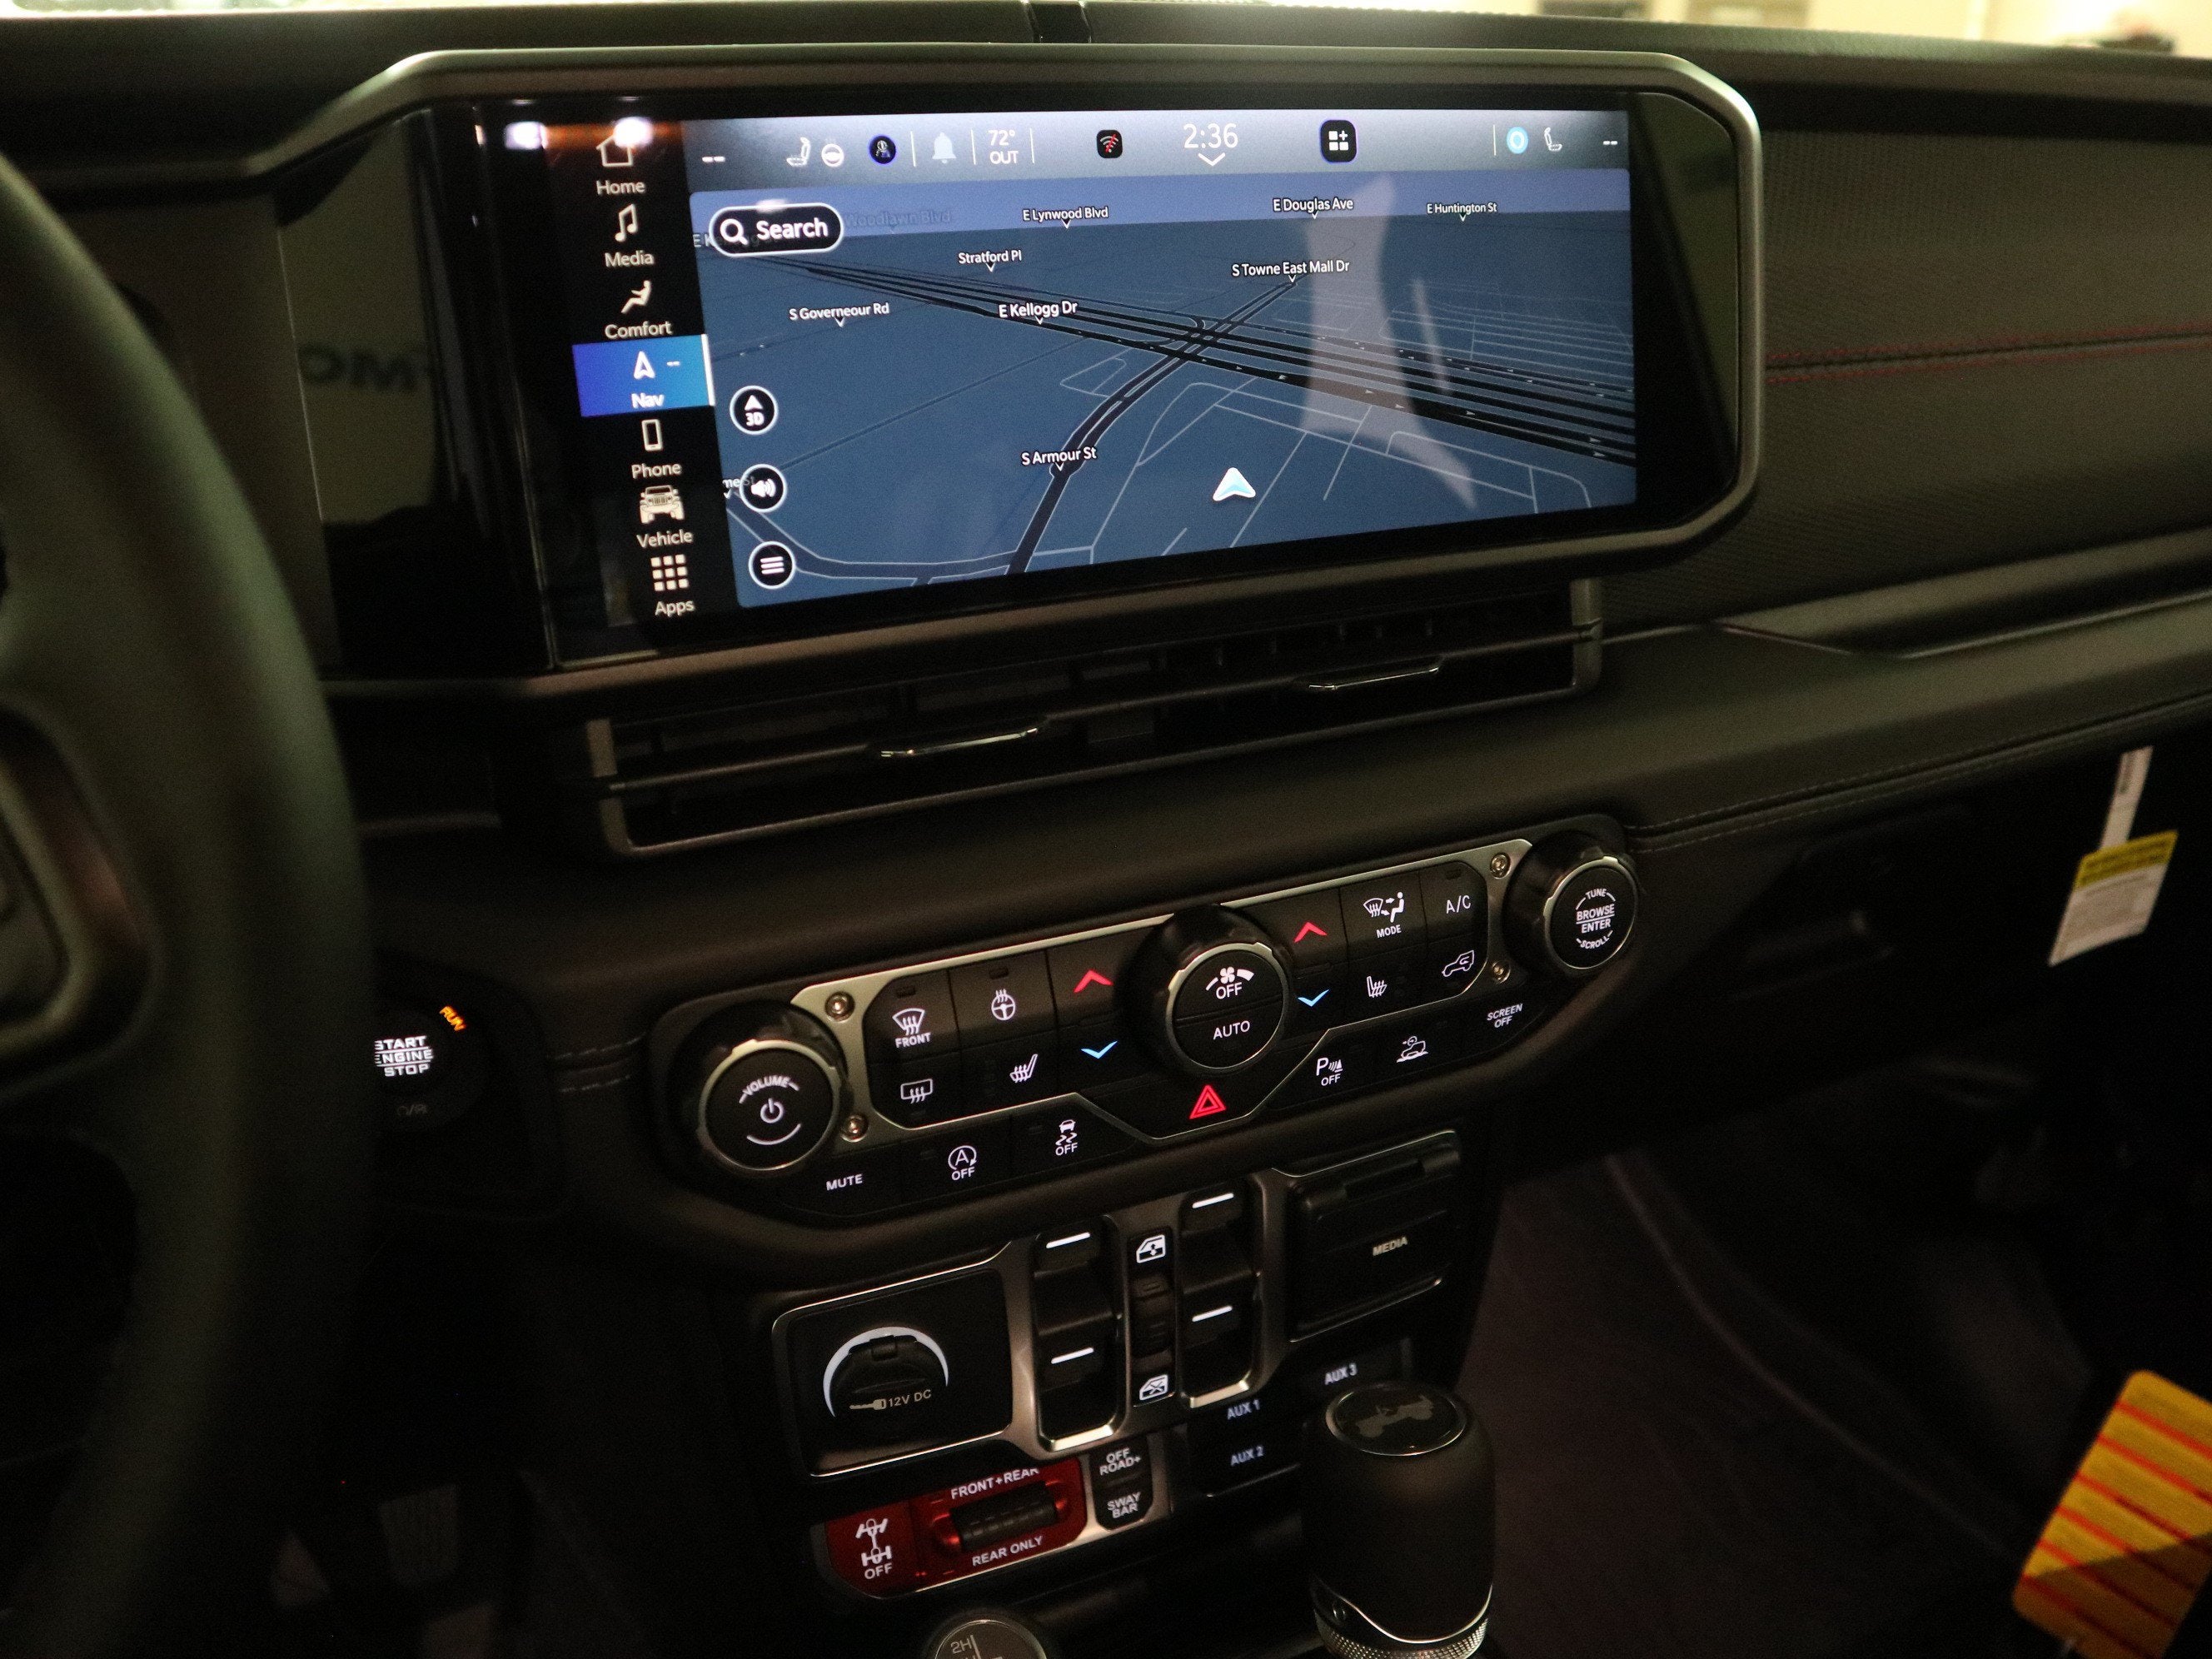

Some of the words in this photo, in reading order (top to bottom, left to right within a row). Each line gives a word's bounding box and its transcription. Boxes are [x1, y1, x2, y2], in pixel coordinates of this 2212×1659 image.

[988, 130, 1015, 146] 72°
[1183, 123, 1238, 150] 2:36
[990, 151, 1019, 164] OUT
[596, 180, 645, 196] Home
[1273, 199, 1281, 212] E
[1283, 198, 1330, 213] Douglas
[1333, 198, 1353, 210] Ave
[1427, 204, 1433, 213] E
[1434, 203, 1487, 216] Huntington
[1487, 202, 1497, 212] St
[1023, 209, 1030, 221] E
[1032, 207, 1083, 223] Lynwood
[1084, 207, 1108, 218] Blvd
[756, 218, 829, 241] Search
[605, 252, 655, 267] Media
[958, 251, 1009, 264] Stratford
[1011, 249, 1022, 261] Pl
[1233, 264, 1240, 276] S
[1241, 263, 1281, 276] Towne
[1283, 262, 1308, 274] East
[1309, 260, 1333, 272] Mall
[1336, 259, 1349, 272] Dr
[790, 309, 798, 321] S
[800, 306, 871, 319] Governeour
[874, 302, 889, 316] Rd
[999, 305, 1007, 317] E
[1010, 302, 1059, 318] Kellogg
[1061, 301, 1077, 314] Dr
[605, 321, 673, 340] Comfort
[631, 392, 664, 408] Nav
[745, 412, 765, 426] 3D
[1021, 452, 1030, 466] S
[1032, 450, 1081, 464] Armour
[1083, 446, 1097, 460] St
[631, 461, 682, 480] Phone
[636, 529, 694, 548] Vehicle
[655, 599, 695, 617] Apps
[1585, 888, 1607, 899] TUNE
[1446, 894, 1472, 914] A/C
[1577, 904, 1615, 921] BROWSE
[1376, 924, 1402, 938] MODE
[1582, 918, 1612, 934] ENTER
[1580, 935, 1610, 949] SCROLL
[1216, 981, 1242, 999] OFF
[439, 1006, 466, 1032] RUN
[1487, 1004, 1523, 1022] SCREEN
[1493, 1015, 1512, 1029] OFF
[1213, 1019, 1251, 1040] AUTO
[375, 1035, 427, 1050] START
[894, 1031, 932, 1049] FRONT
[384, 1064, 430, 1077] STOP
[742, 1075, 790, 1096] VOLUME
[1321, 1073, 1342, 1087] OFF
[1055, 1142, 1079, 1156] OFF
[826, 1173, 863, 1191] MUTE
[952, 1166, 975, 1181] OFF
[1373, 1236, 1408, 1257] MEDIA
[1324, 1366, 1347, 1386] AUX
[1348, 1363, 1358, 1377] 3
[888, 1392, 911, 1407] 12V
[914, 1388, 932, 1402] DC
[1227, 1402, 1250, 1420] AUX
[1253, 1399, 1260, 1412] 1
[1106, 1447, 1130, 1464] OFF
[1230, 1448, 1254, 1467] AUX
[1255, 1446, 1264, 1458] 2
[1099, 1455, 1141, 1476] ROAD+
[1107, 1492, 1141, 1511] SWAY
[1112, 1502, 1138, 1519] BAR
[971, 1546, 1008, 1567] REAR
[1009, 1535, 1044, 1554] ONLY
[864, 1562, 893, 1580] OFF
[950, 1637, 973, 1655] 2H
